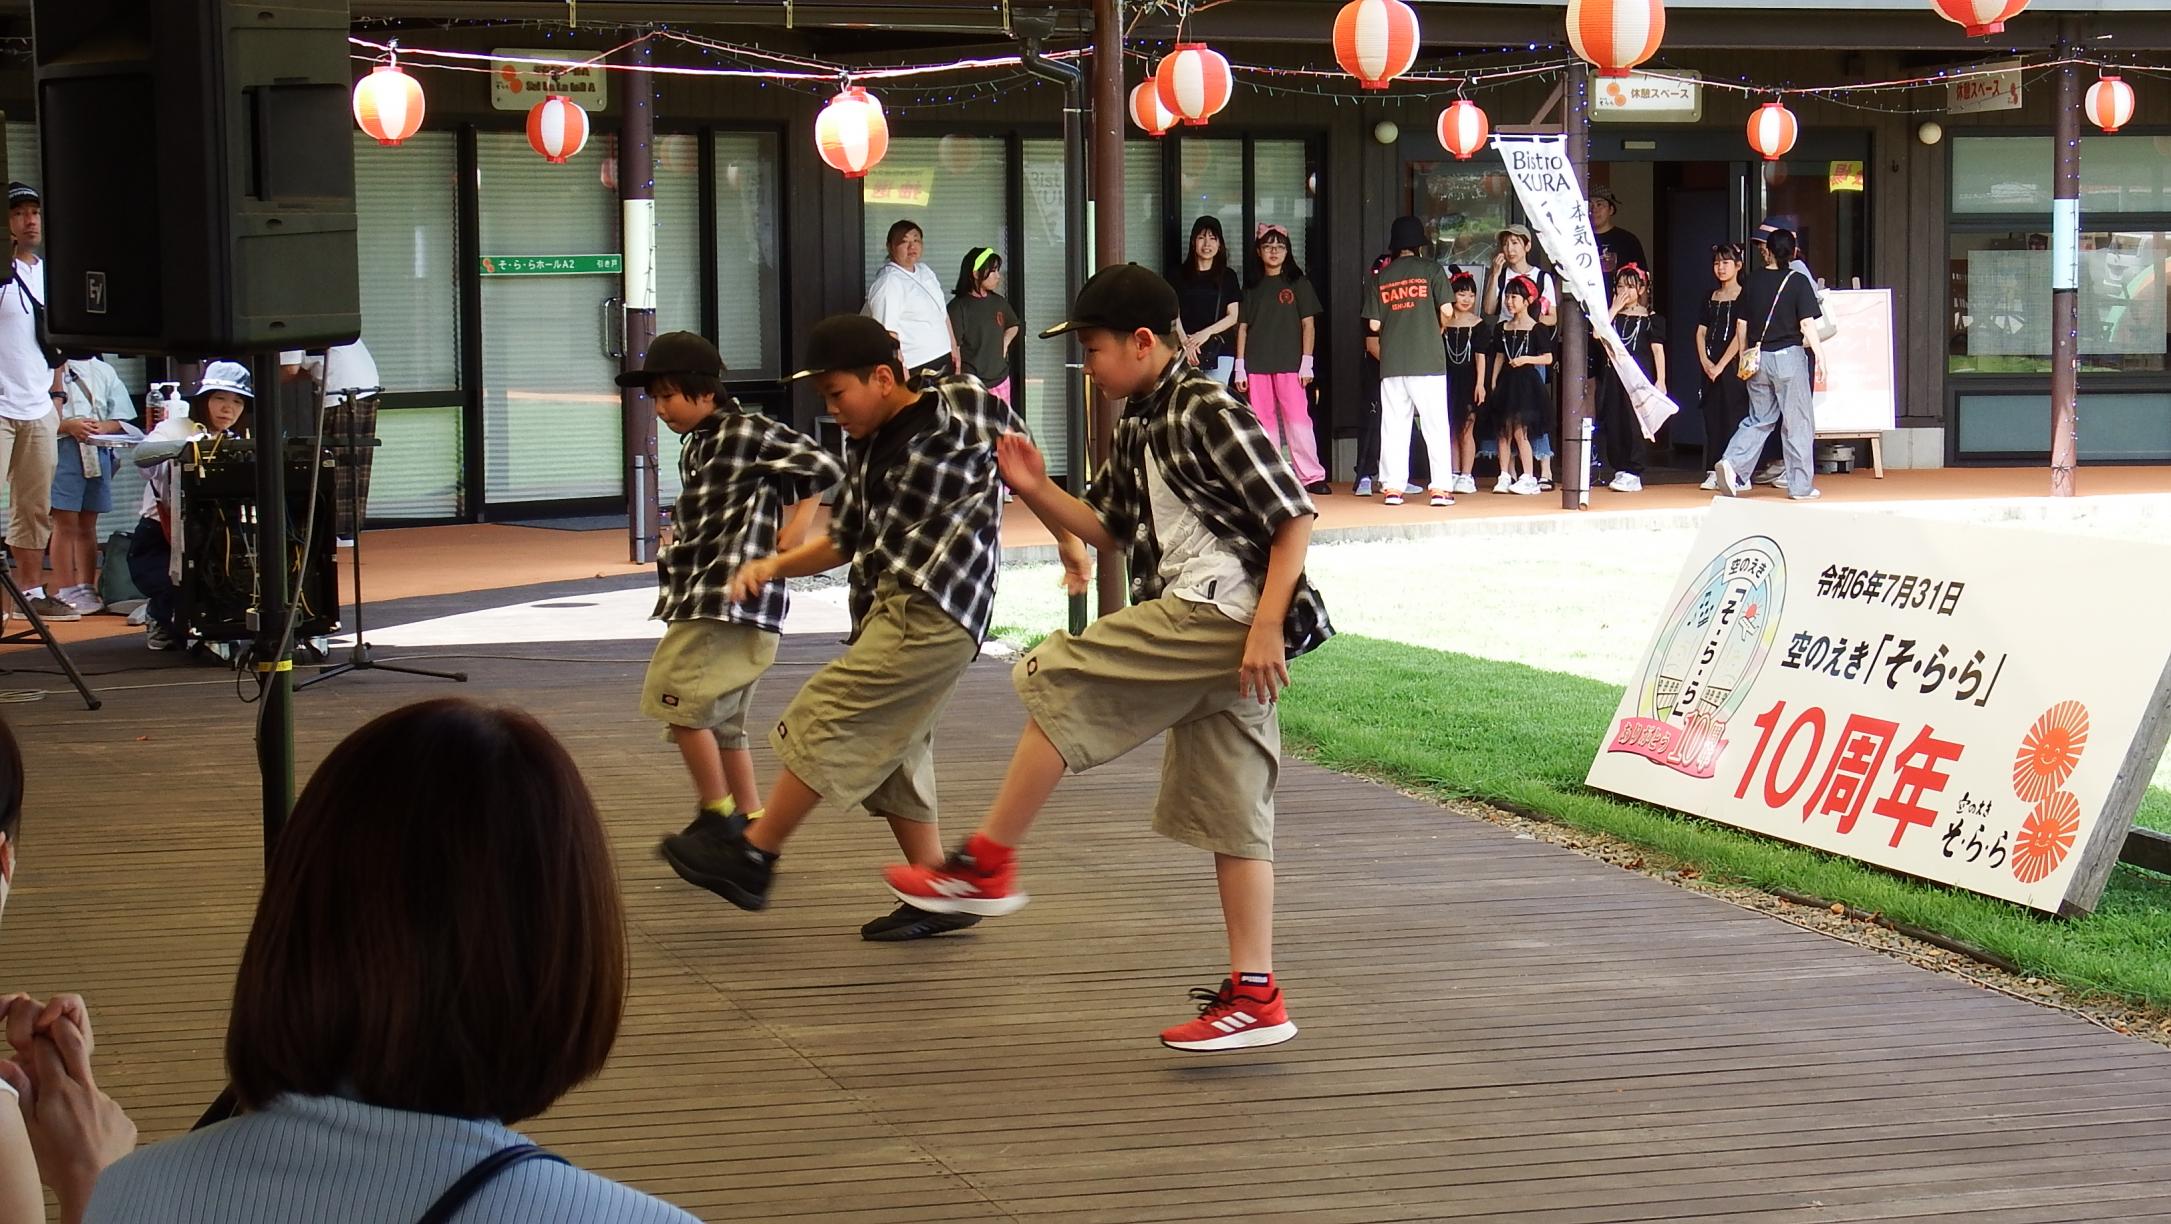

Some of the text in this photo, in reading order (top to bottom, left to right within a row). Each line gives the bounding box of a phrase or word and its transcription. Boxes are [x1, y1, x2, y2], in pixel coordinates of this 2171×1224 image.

[1631, 88, 1689, 99] 休憩スペース
[1512, 150, 1563, 170] Bistro
[1517, 173, 1571, 192] KURA
[1381, 285, 1428, 304] DANCE
[1728, 557, 1767, 579] 空のえき
[1816, 564, 1966, 617] 令和6年7月31日
[1618, 721, 1672, 754] ありがとう
[1733, 700, 1965, 849] 10周年
[1956, 791, 1992, 818] 空のえき
